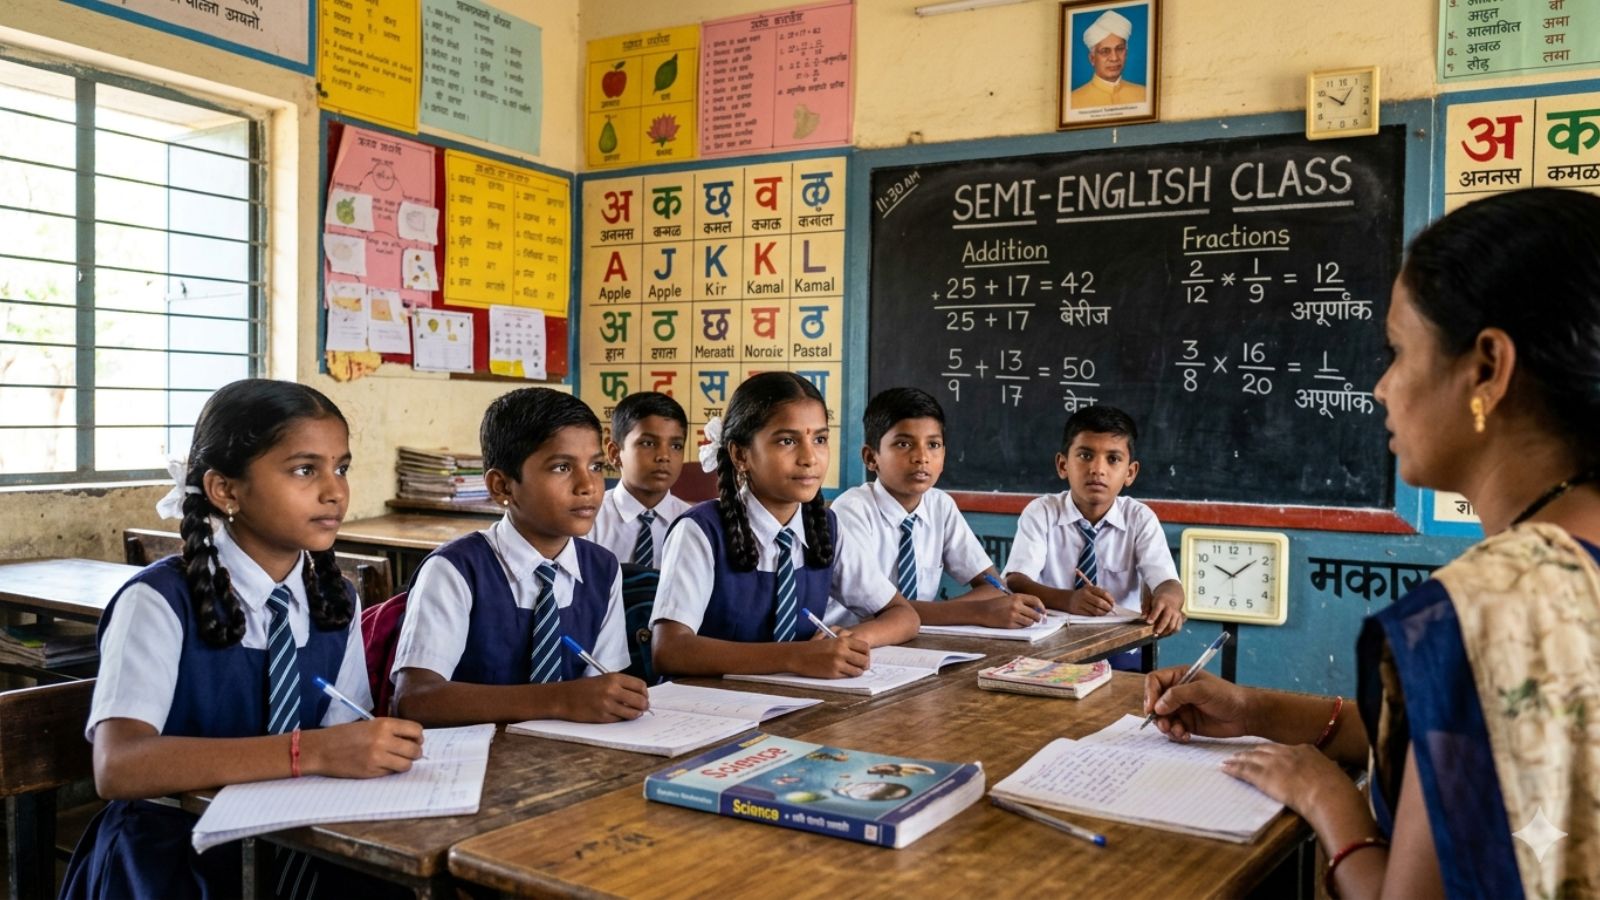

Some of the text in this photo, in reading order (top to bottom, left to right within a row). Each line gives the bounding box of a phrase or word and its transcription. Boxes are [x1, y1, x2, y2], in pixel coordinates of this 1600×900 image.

[1461, 109, 1600, 162] अ क
[904, 171, 920, 188] AM
[1459, 164, 1600, 187] अननस कमळ
[952, 155, 1352, 221] SEMI-ENGLISH CLASS
[600, 190, 633, 225] अ
[652, 185, 683, 219] क
[703, 181, 734, 218] छ
[754, 176, 783, 211] व
[1183, 224, 1290, 250] Fractions
[603, 240, 827, 282] A J K K L
[962, 238, 1048, 263] Addition
[1190, 260, 1204, 277] 2
[1254, 258, 1259, 275] 1
[1317, 262, 1345, 283] 12
[600, 277, 835, 301] Apple Apple Kir Kamal Kamal
[946, 277, 976, 299] 25
[1008, 275, 1030, 296] 17
[1061, 271, 1096, 294] 42
[1187, 283, 1264, 303] 12 9
[946, 311, 976, 331] 25
[1008, 311, 1030, 331] 17
[1060, 299, 1112, 328] बेरीज
[600, 310, 632, 343] अ
[652, 310, 678, 342] ठ
[702, 309, 731, 341] छ
[794, 343, 832, 358] Pastal
[1182, 340, 1198, 360] 3
[1243, 342, 1266, 362] 16
[948, 348, 962, 370] 5
[1000, 350, 1022, 371] 13
[1063, 357, 1096, 380] 50
[600, 371, 628, 401] फ
[698, 371, 729, 404] स
[1183, 368, 1272, 395] 8 20
[948, 379, 1022, 407] 9 17
[1198, 554, 1209, 563] 10
[1213, 545, 1222, 554] 11
[1228, 546, 1239, 554] 12
[1248, 547, 1252, 556] 1
[1262, 556, 1269, 566] 2
[1198, 570, 1205, 579] 9
[1262, 574, 1269, 583] 3
[1198, 586, 1206, 595] 8
[1214, 596, 1220, 606] 7
[1262, 591, 1268, 600] 4
[1229, 598, 1237, 607] 6
[1246, 599, 1253, 608] 5
[702, 747, 787, 779] Science
